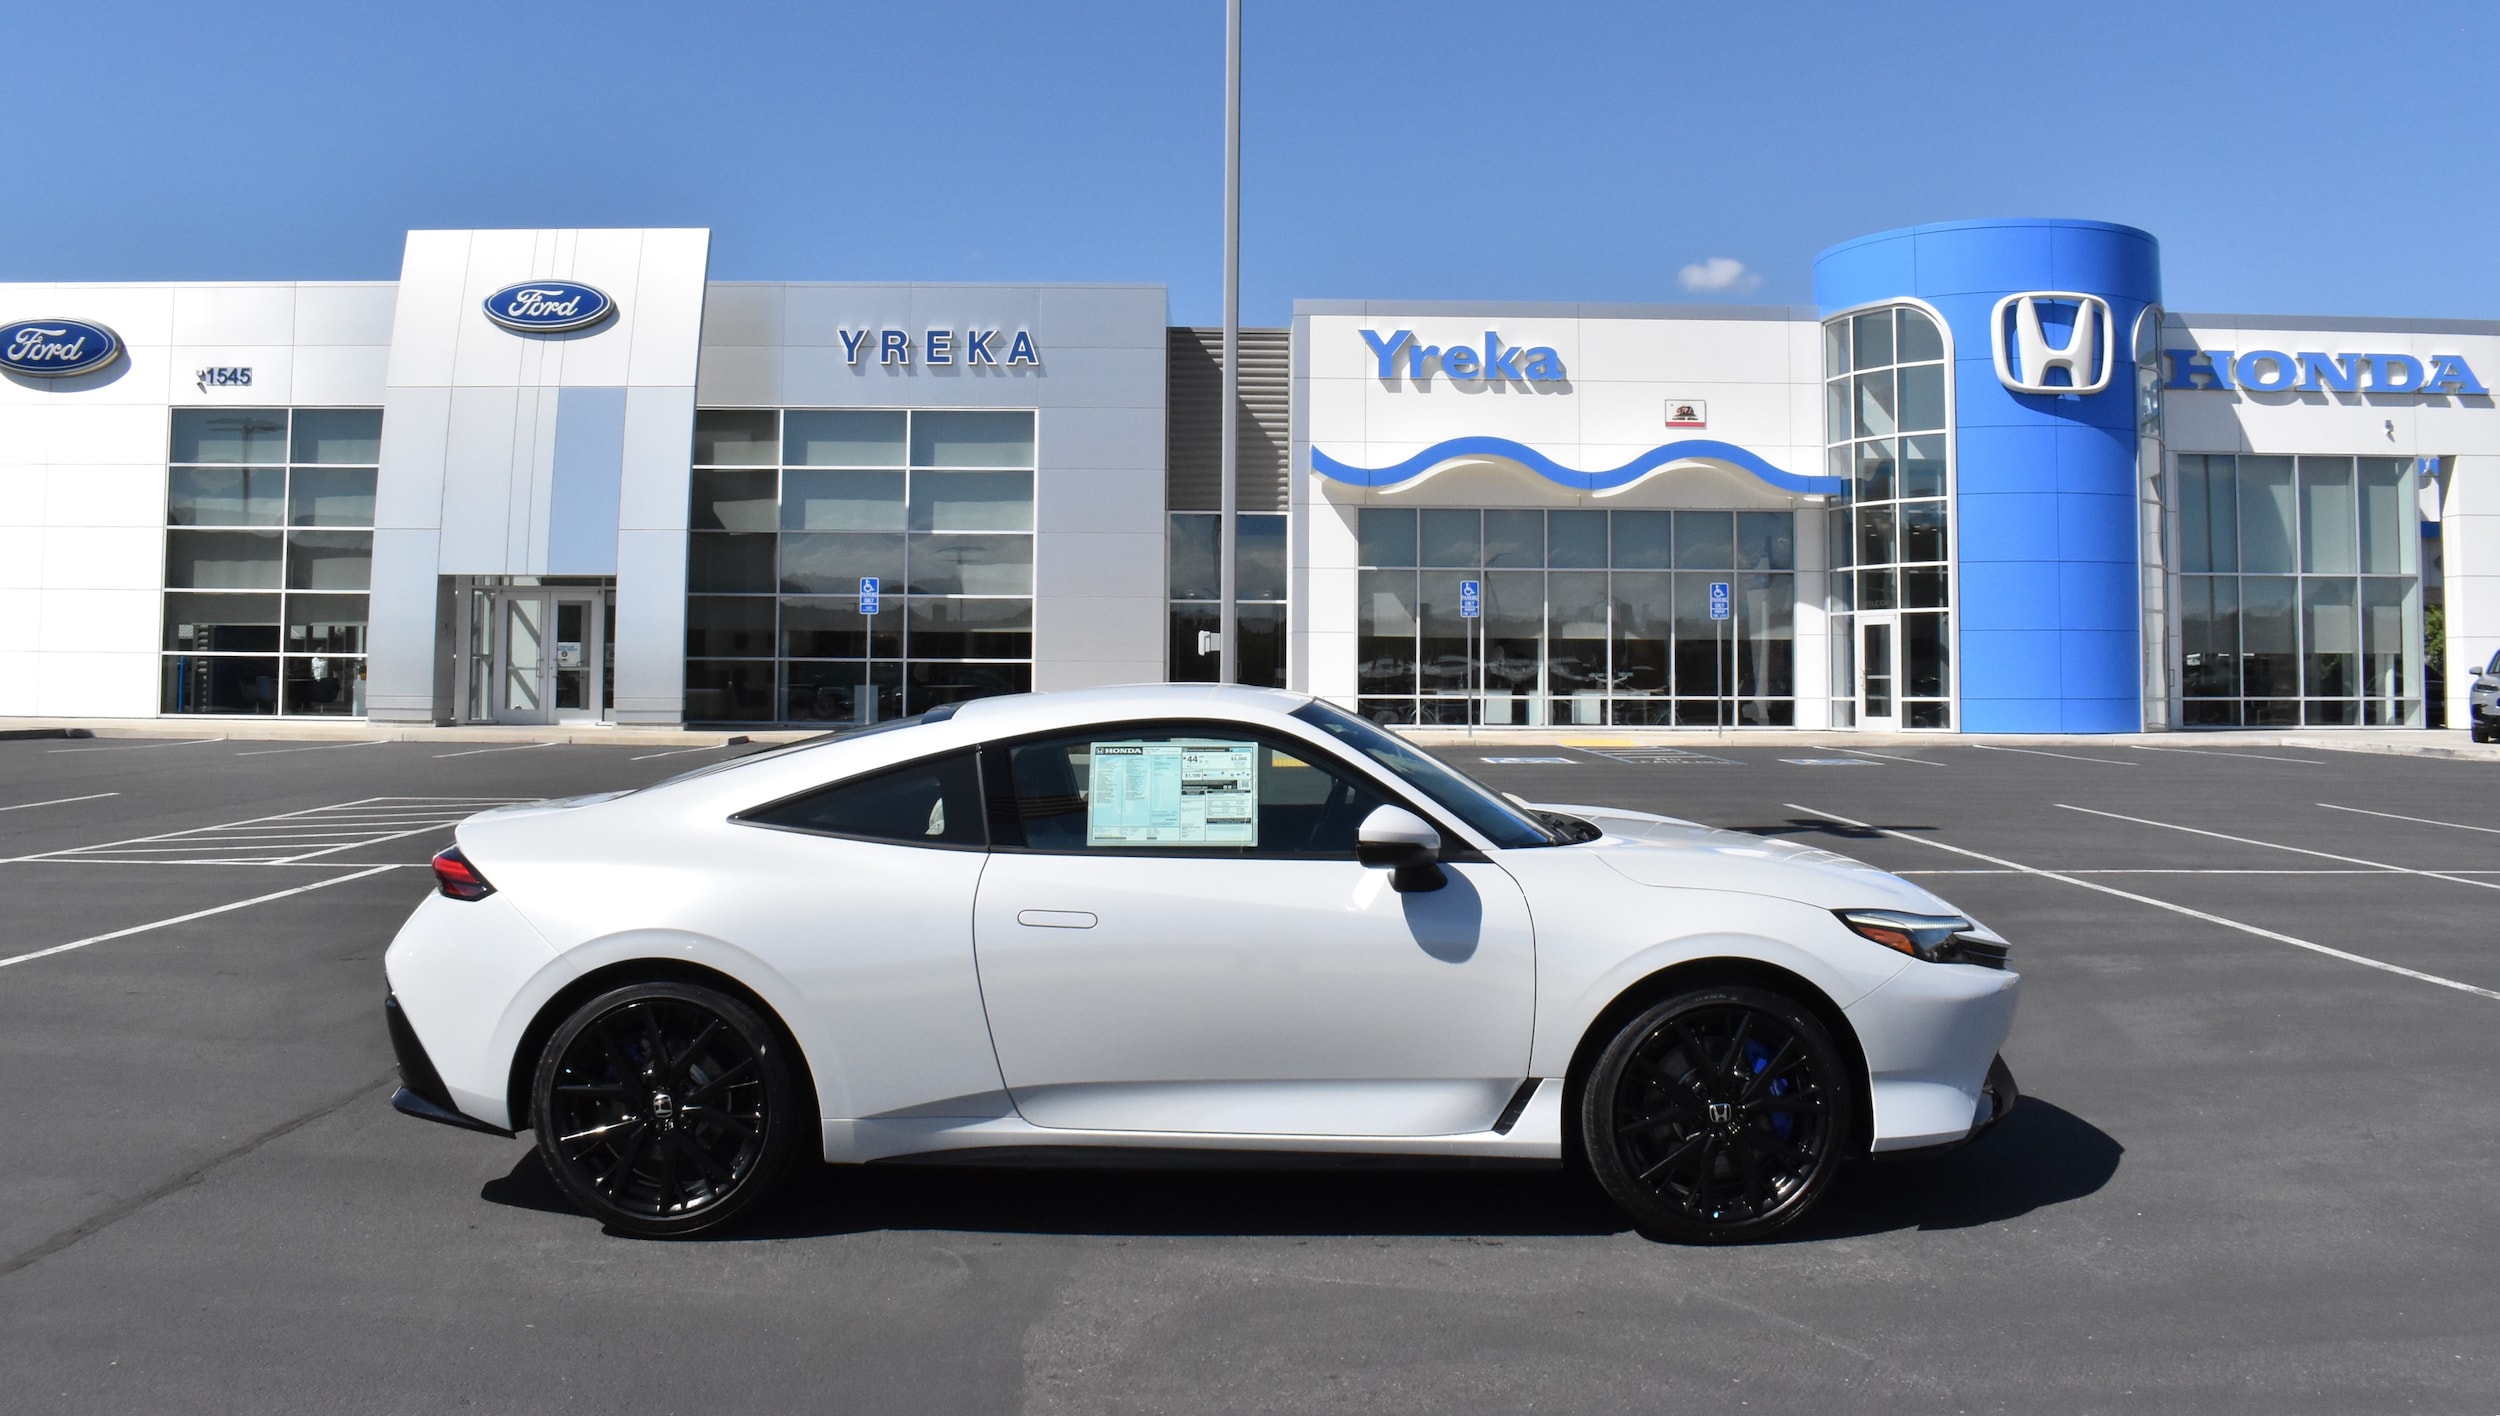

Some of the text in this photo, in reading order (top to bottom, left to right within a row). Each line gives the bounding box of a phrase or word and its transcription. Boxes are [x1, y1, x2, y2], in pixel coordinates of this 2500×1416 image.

[508, 289, 581, 317] Ford
[7, 327, 86, 361] Ford
[837, 329, 1040, 366] YREKA
[1358, 329, 1566, 381] Yreka
[206, 368, 251, 384] 1545
[2164, 348, 2490, 395] HONDA
[1187, 755, 1198, 763] 44
